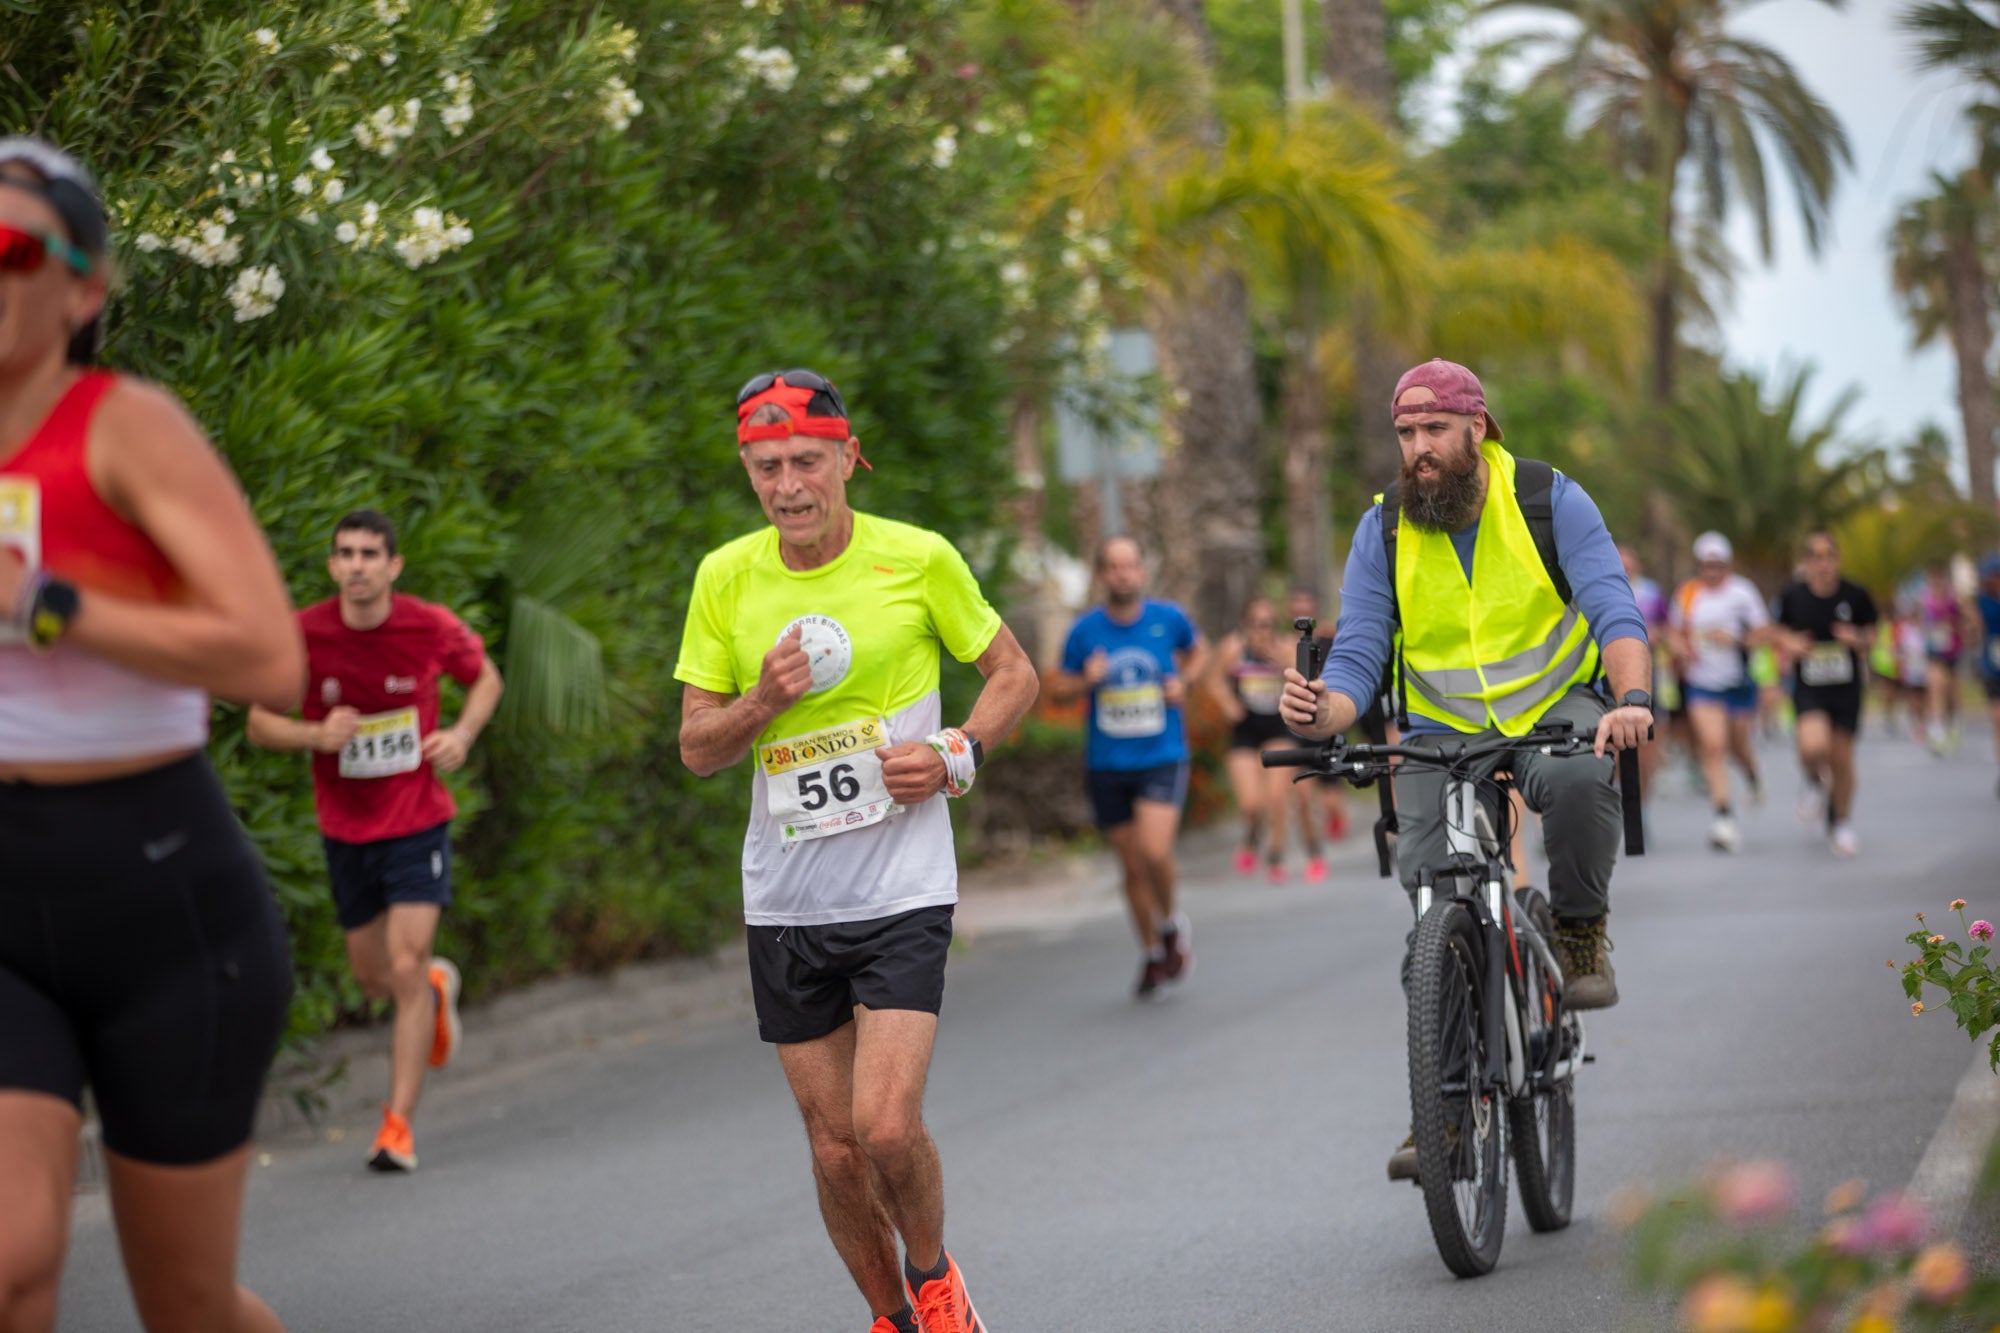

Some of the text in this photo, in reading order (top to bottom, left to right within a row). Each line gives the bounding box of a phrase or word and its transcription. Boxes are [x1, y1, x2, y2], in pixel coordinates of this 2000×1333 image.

[821, 618, 847, 645] BIRRAS
[774, 747, 792, 765] 38
[791, 735, 857, 763] FONDO
[793, 738, 816, 749] GRAN
[817, 729, 848, 742] PREMIO
[797, 763, 860, 811] 56
